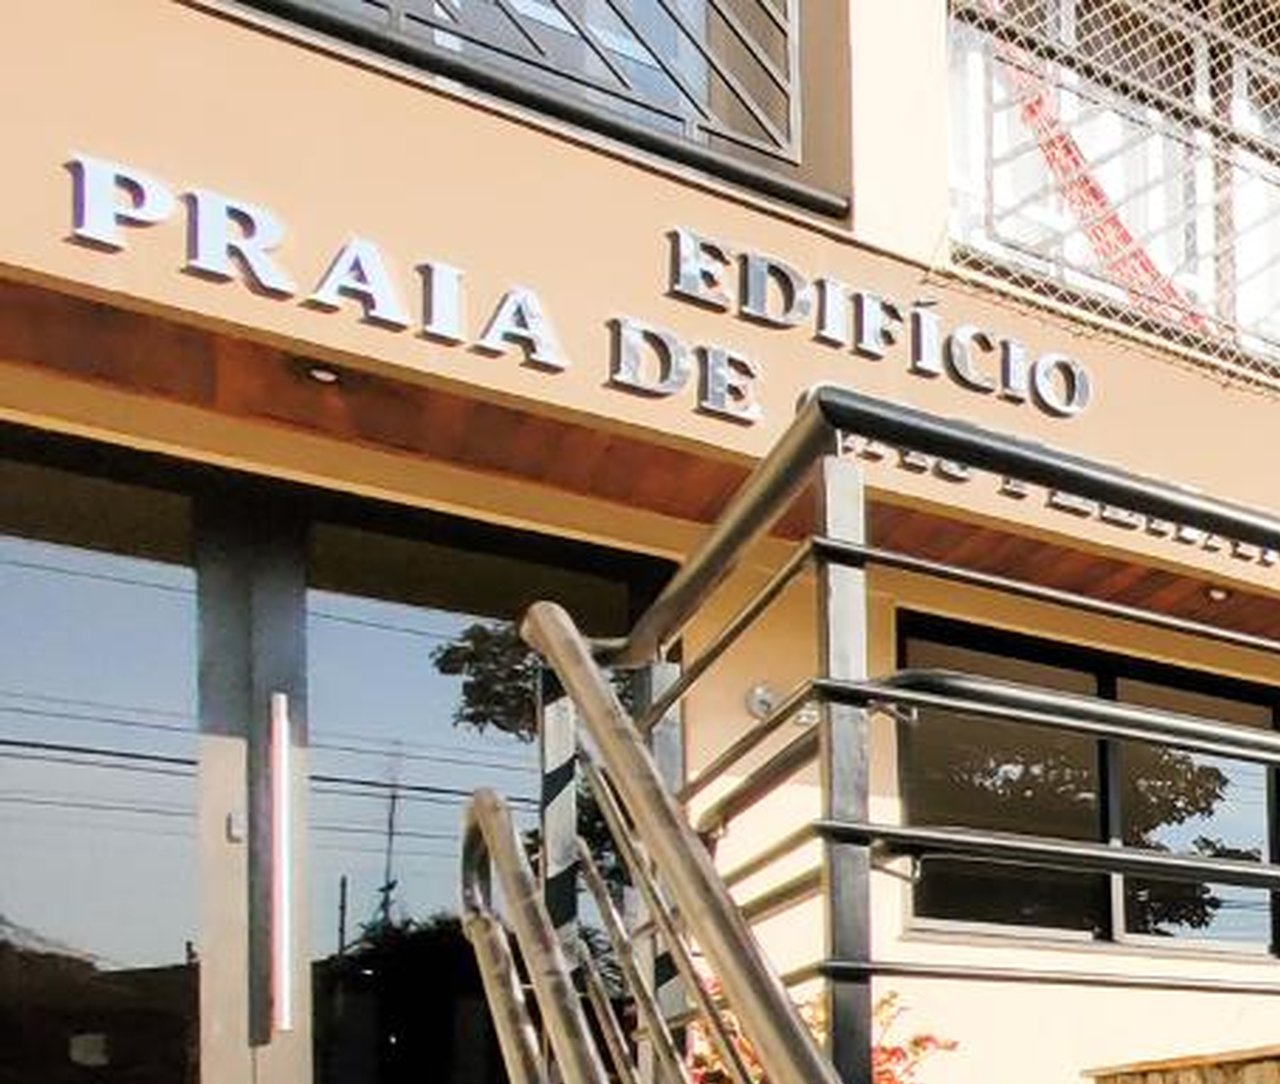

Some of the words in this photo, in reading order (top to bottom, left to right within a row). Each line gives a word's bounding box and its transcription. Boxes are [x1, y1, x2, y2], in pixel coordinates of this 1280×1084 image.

[65, 152, 570, 374] PRAIA
[606, 316, 764, 425] DE
[664, 224, 1091, 418] EDIFÍCIO
